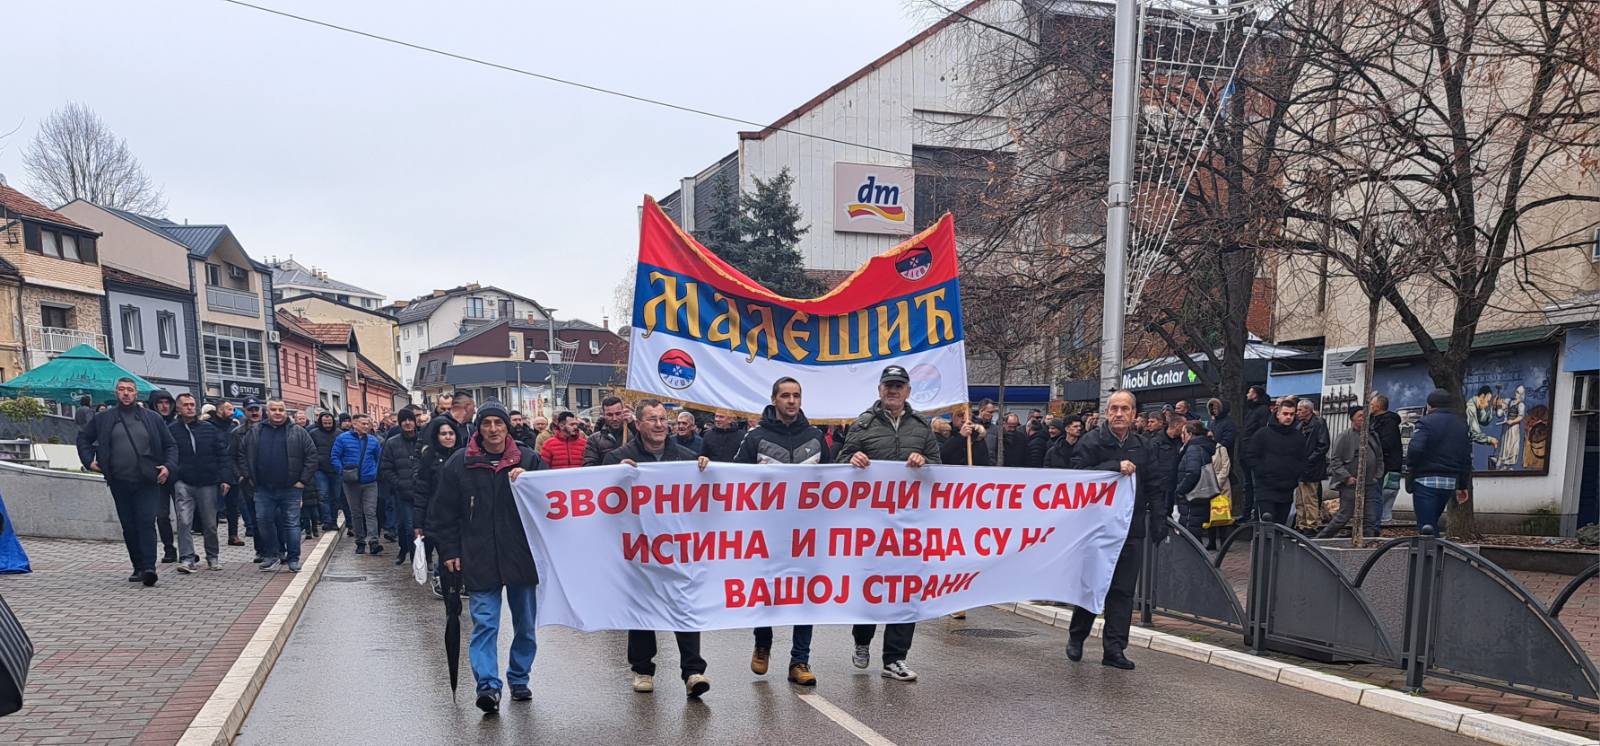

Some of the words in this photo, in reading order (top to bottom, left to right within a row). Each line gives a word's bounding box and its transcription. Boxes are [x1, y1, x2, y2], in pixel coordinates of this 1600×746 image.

[857, 175, 900, 205] dm
[1122, 371, 1149, 389] Mobil
[1151, 370, 1184, 386] Centar
[546, 482, 787, 521] ЗВОРНИЧКИ
[799, 480, 920, 514] БОРЦИ
[930, 482, 1027, 511] НИСТЕ
[1032, 481, 1118, 510] САМИ
[623, 530, 769, 565] ИСТИНА
[791, 527, 816, 558] И
[828, 527, 966, 562] ПРАВДА
[974, 527, 1012, 557] СУ
[1018, 527, 1056, 552] Н
[724, 575, 851, 609] ВАШОЈ
[862, 571, 980, 604] СТРАНИ
